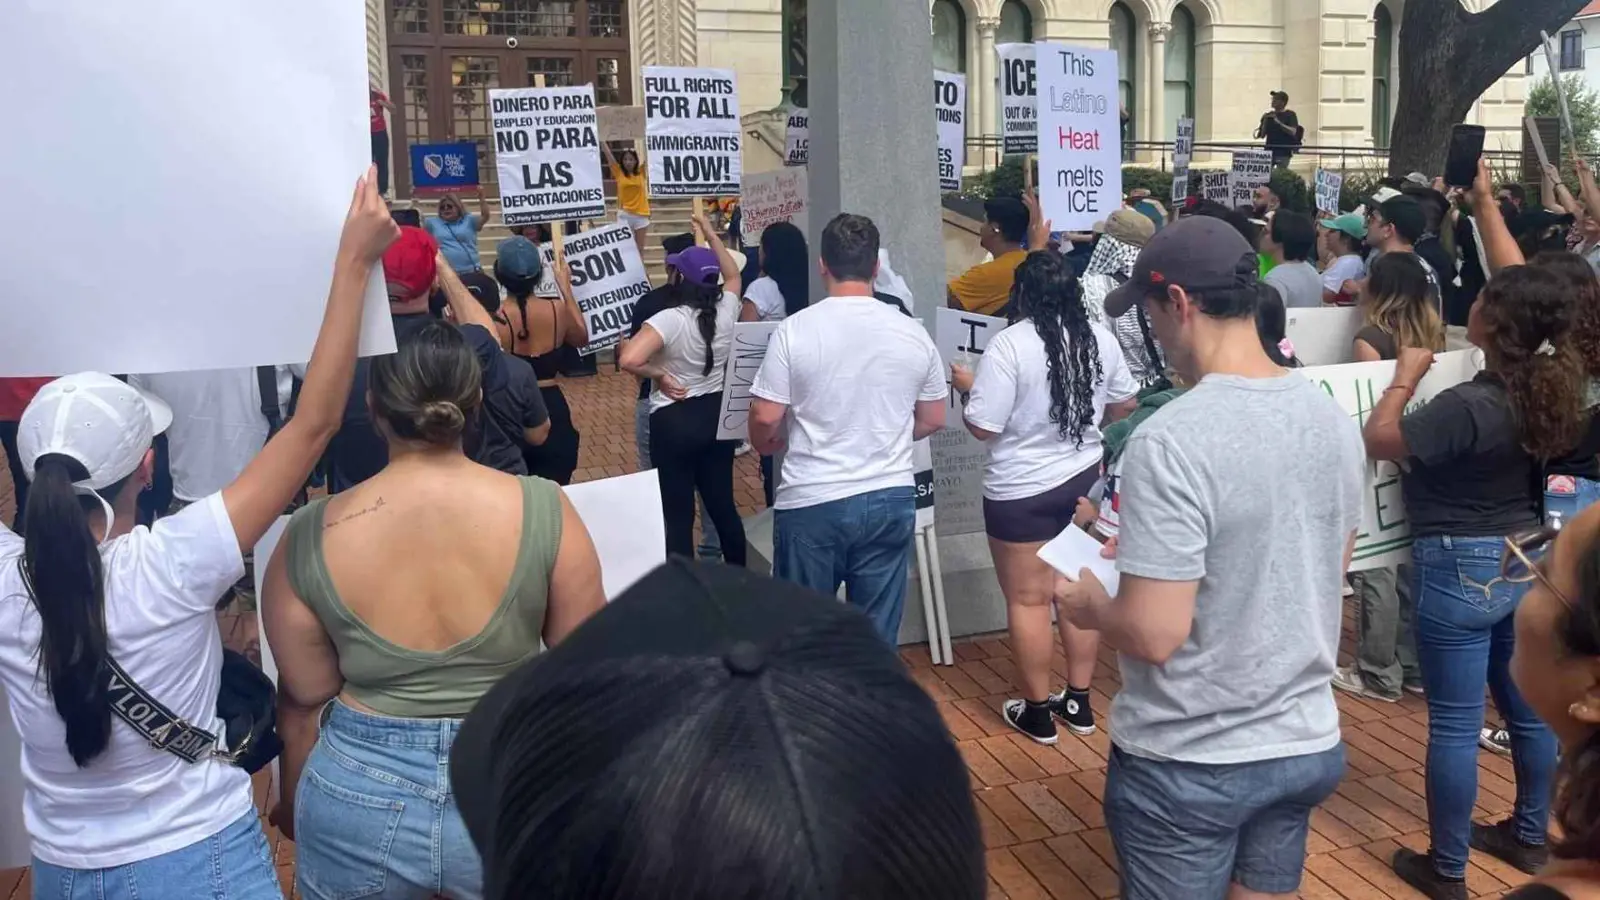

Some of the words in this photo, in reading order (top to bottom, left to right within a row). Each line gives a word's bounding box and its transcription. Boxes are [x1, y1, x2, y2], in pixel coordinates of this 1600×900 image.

[1058, 51, 1094, 77] This
[645, 77, 680, 92] FULL
[684, 78, 733, 94] RIGHTS
[1004, 59, 1037, 96] ICE
[492, 96, 549, 113] DINERO
[552, 94, 594, 110] PARA
[646, 96, 690, 118] FOR
[696, 97, 735, 119] ALL
[1050, 86, 1107, 115] Latino
[494, 117, 533, 128] EMPLEO
[534, 116, 542, 126] Y
[543, 114, 595, 126] EDUCACION
[1005, 107, 1020, 119] OUT
[1022, 107, 1031, 119] OF
[496, 130, 529, 153] NO
[535, 126, 597, 150] PARA
[647, 135, 739, 151] IMMIGRANTS
[1059, 126, 1099, 150] Heat
[522, 161, 574, 190] LAS
[662, 155, 731, 182] NOW!
[1057, 165, 1104, 187] melts
[1204, 173, 1229, 187] SHUT
[1246, 164, 1270, 173] PARA
[502, 188, 603, 208] DEPORTACIONES
[1068, 190, 1099, 213] ICE
[1205, 187, 1229, 199] DOWN
[568, 248, 626, 287] SON
[590, 302, 637, 336] AQU
[115, 692, 173, 744] LOLA
